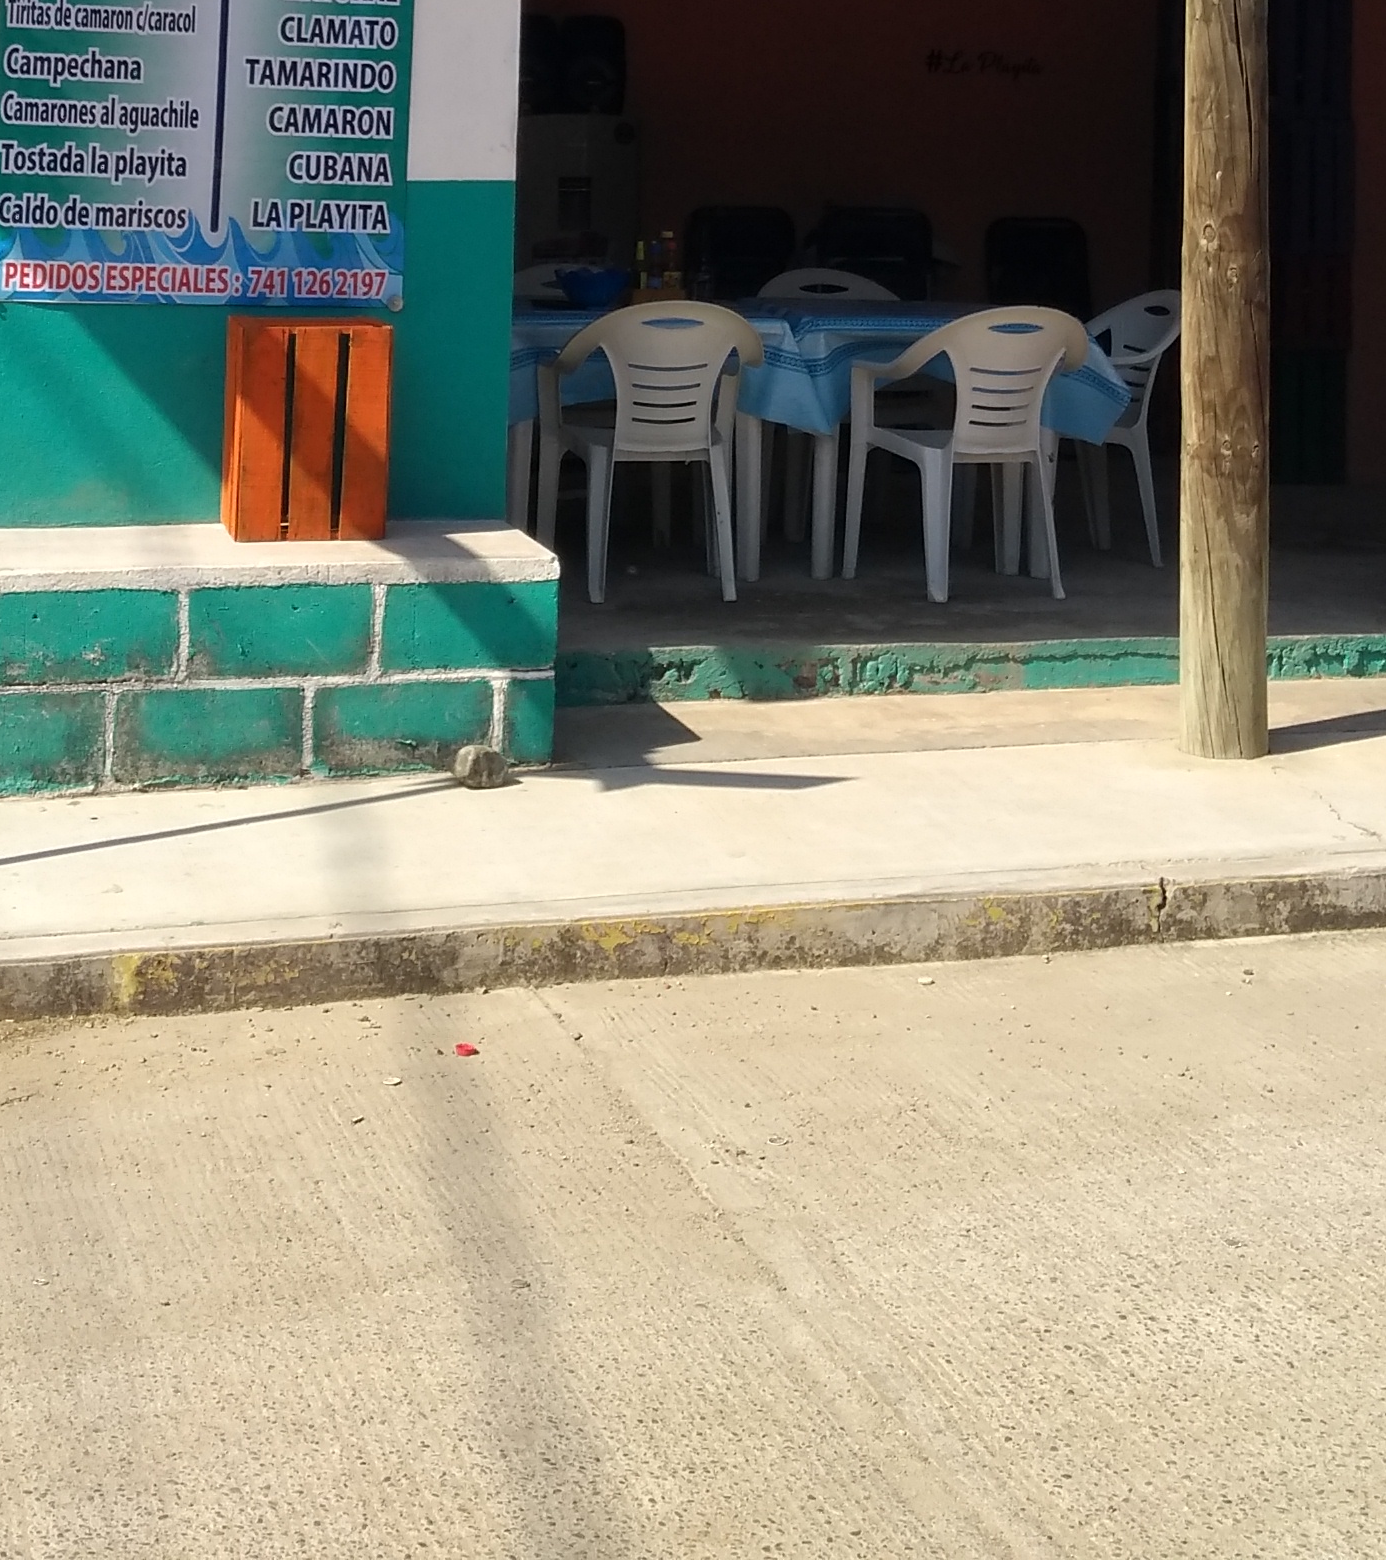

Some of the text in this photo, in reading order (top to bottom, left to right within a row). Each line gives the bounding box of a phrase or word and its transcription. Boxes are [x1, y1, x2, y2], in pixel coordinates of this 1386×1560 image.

[54, 0, 72, 27] de
[74, 7, 133, 30] camaron
[136, 3, 196, 33] c/caracol
[280, 16, 396, 47] CLAMATO
[7, 47, 142, 84] Campechana
[245, 58, 394, 90] TAMARINDO
[3, 93, 199, 134] Camarones al aguachile
[269, 106, 391, 136] CAMARON
[1, 143, 187, 184] Tostada la playita
[289, 153, 390, 183] CUBANA
[64, 197, 89, 227] de
[95, 200, 187, 230] mariscos
[252, 201, 388, 231] LA PLAYITA
[4, 262, 100, 291] PEDIDOS
[250, 269, 286, 295] 741
